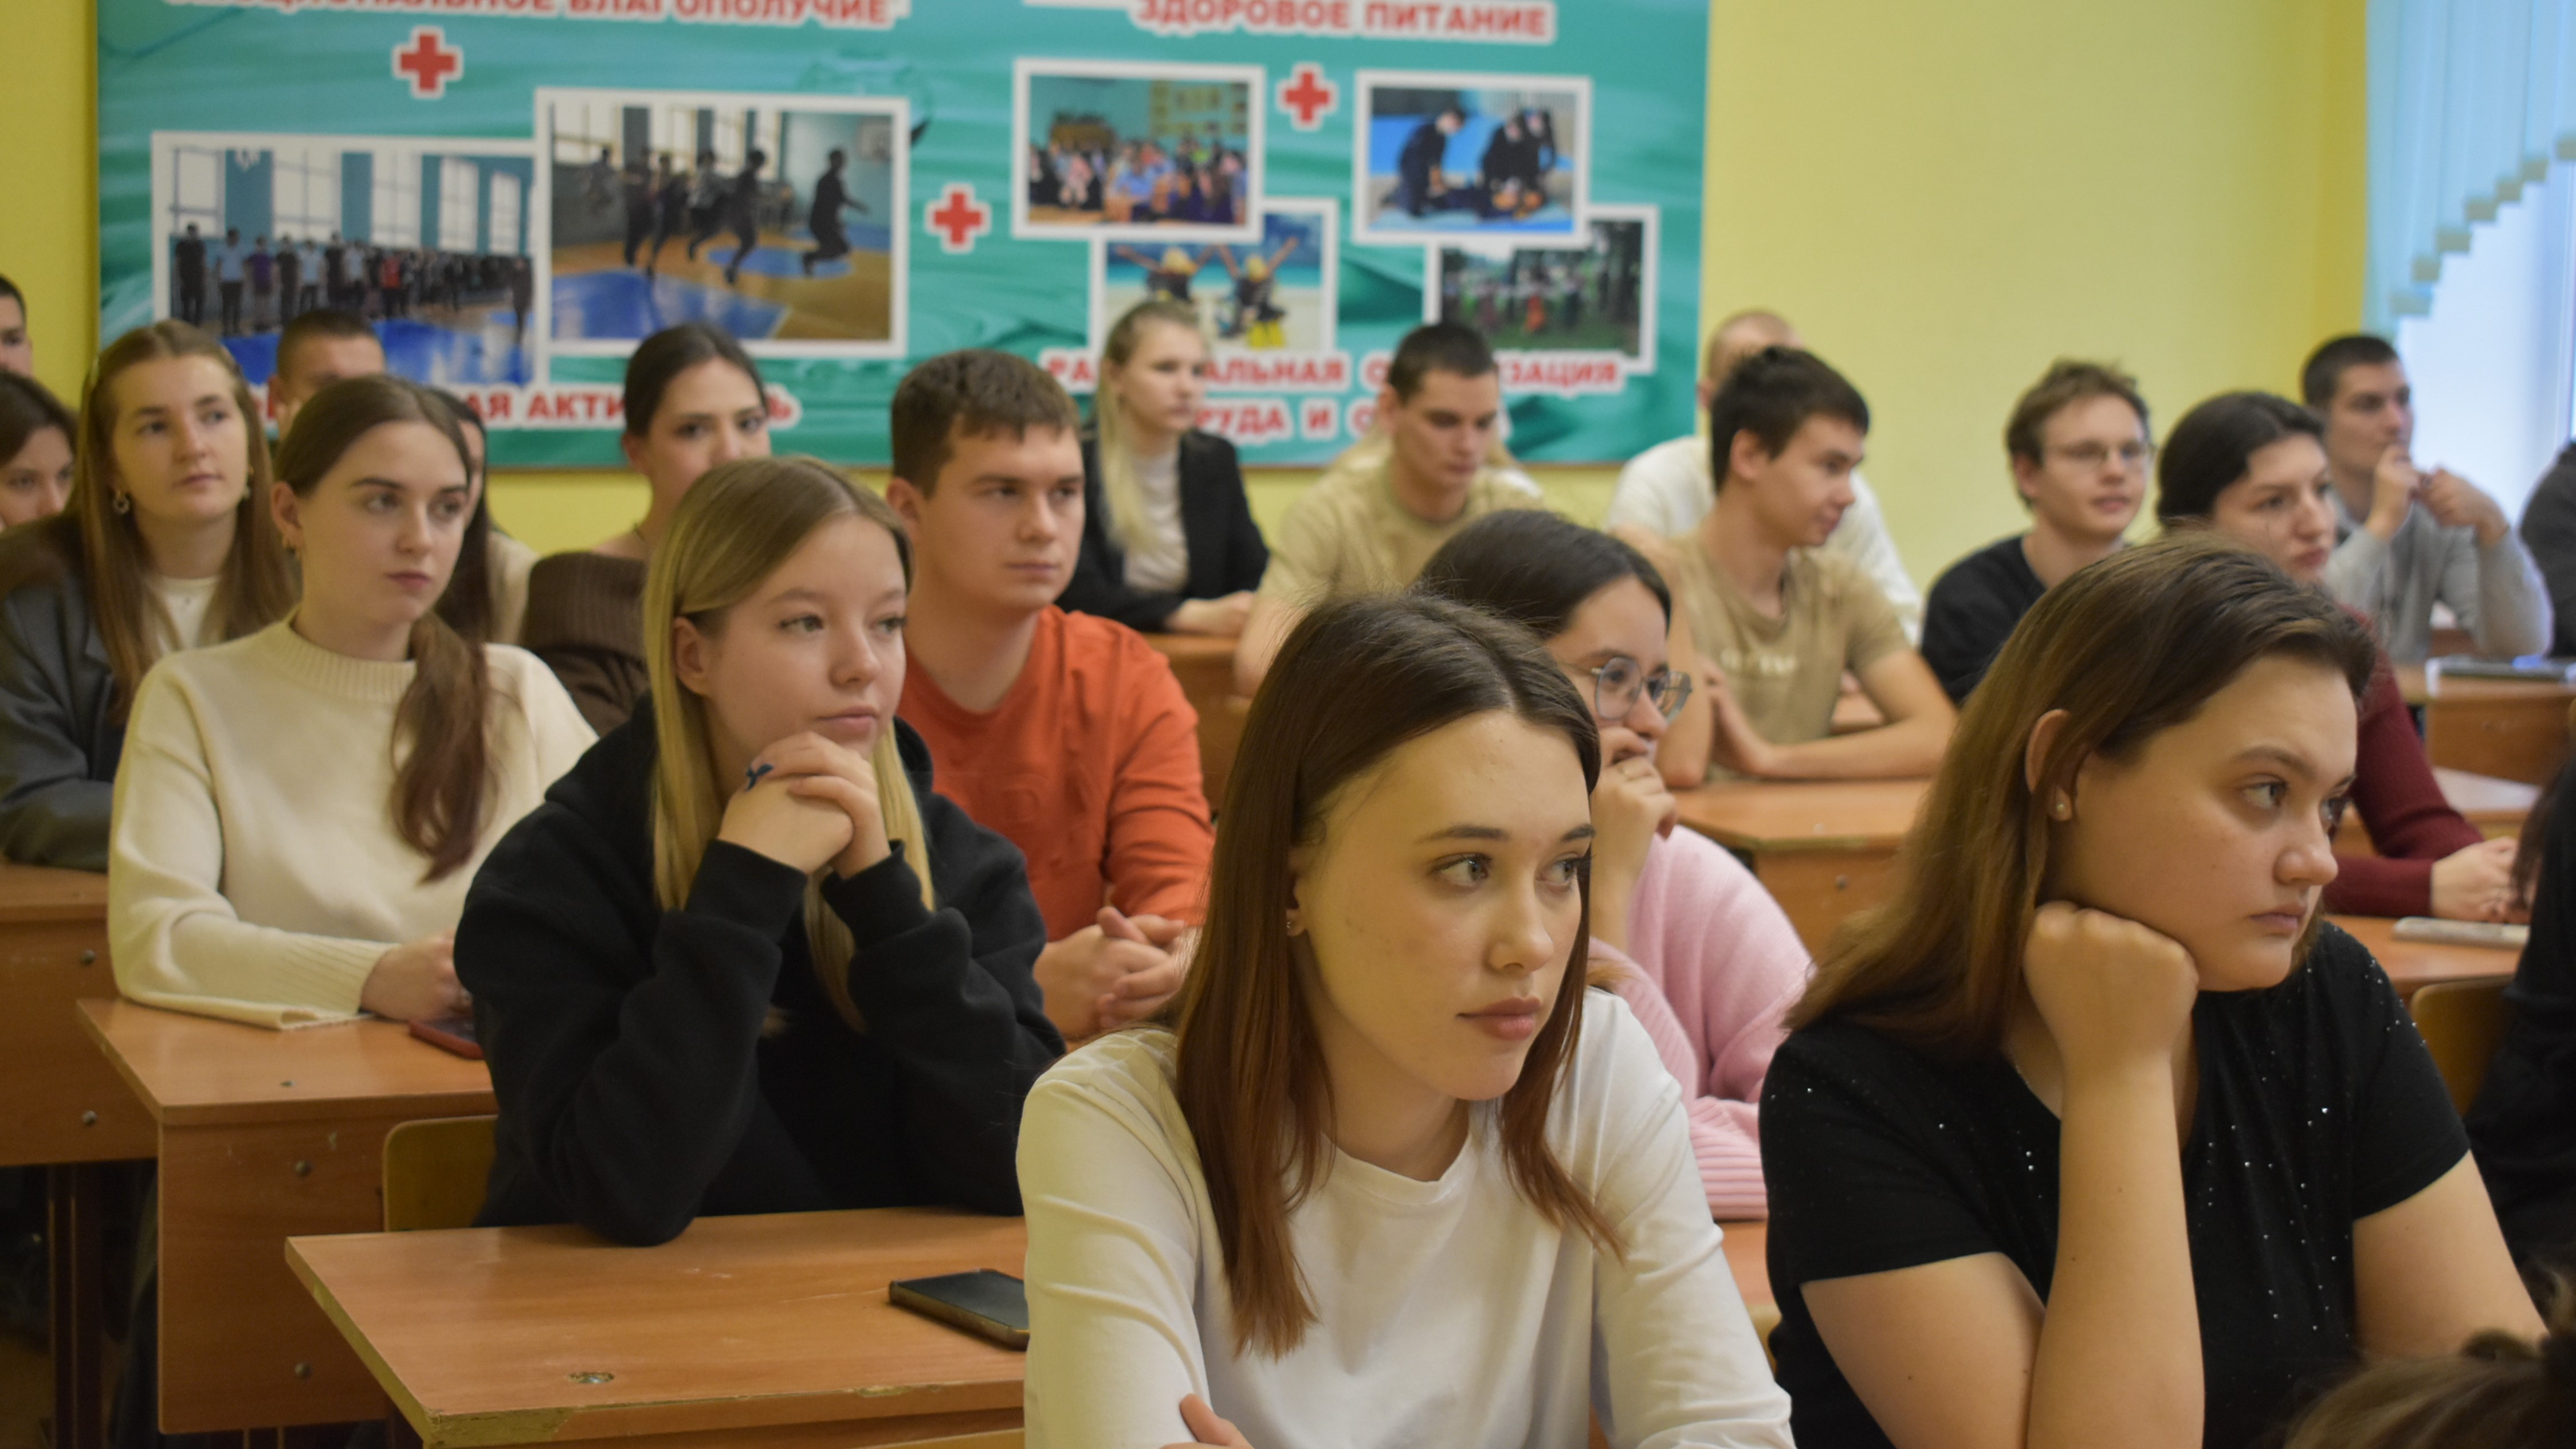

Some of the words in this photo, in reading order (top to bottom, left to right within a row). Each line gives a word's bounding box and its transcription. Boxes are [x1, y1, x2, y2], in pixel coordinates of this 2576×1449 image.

[1140, 0, 1348, 28] ЗДОРОВОЕ
[1364, 3, 1544, 36] ПИТАНИЕ
[1047, 359, 1341, 383] РААЛЬНАЯ
[1195, 407, 1283, 434] РУДА
[1308, 409, 1329, 429] И
